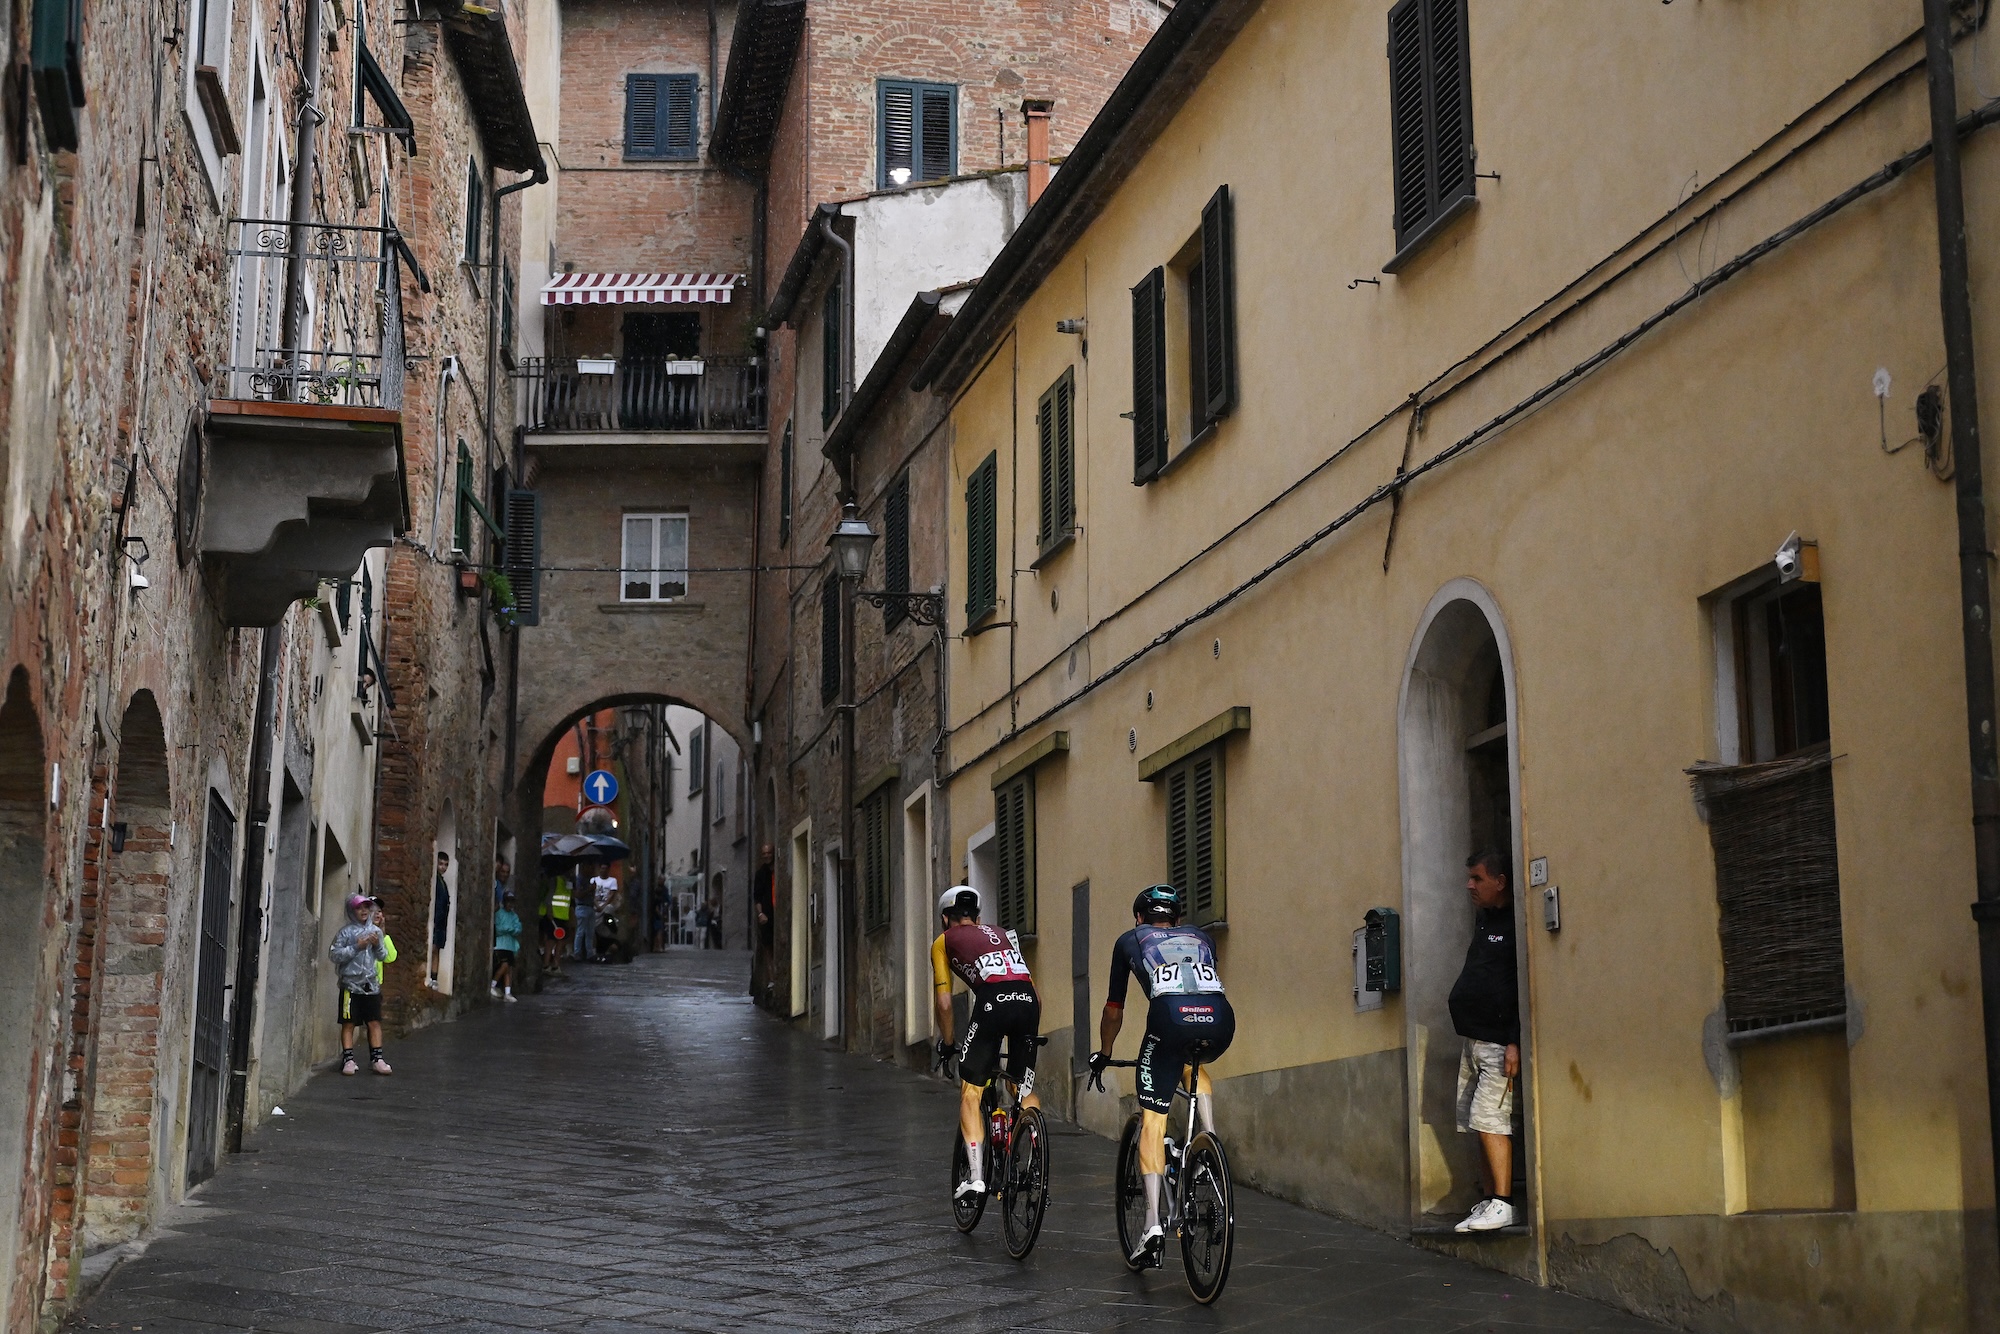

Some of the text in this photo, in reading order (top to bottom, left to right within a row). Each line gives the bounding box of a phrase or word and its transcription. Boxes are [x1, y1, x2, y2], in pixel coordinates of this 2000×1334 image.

[1153, 963, 1180, 984] 157
[996, 992, 1034, 1003] Cofidis
[1141, 1041, 1157, 1066] BANK
[1025, 1070, 1036, 1090] 125
[1140, 1064, 1155, 1092] MBH
